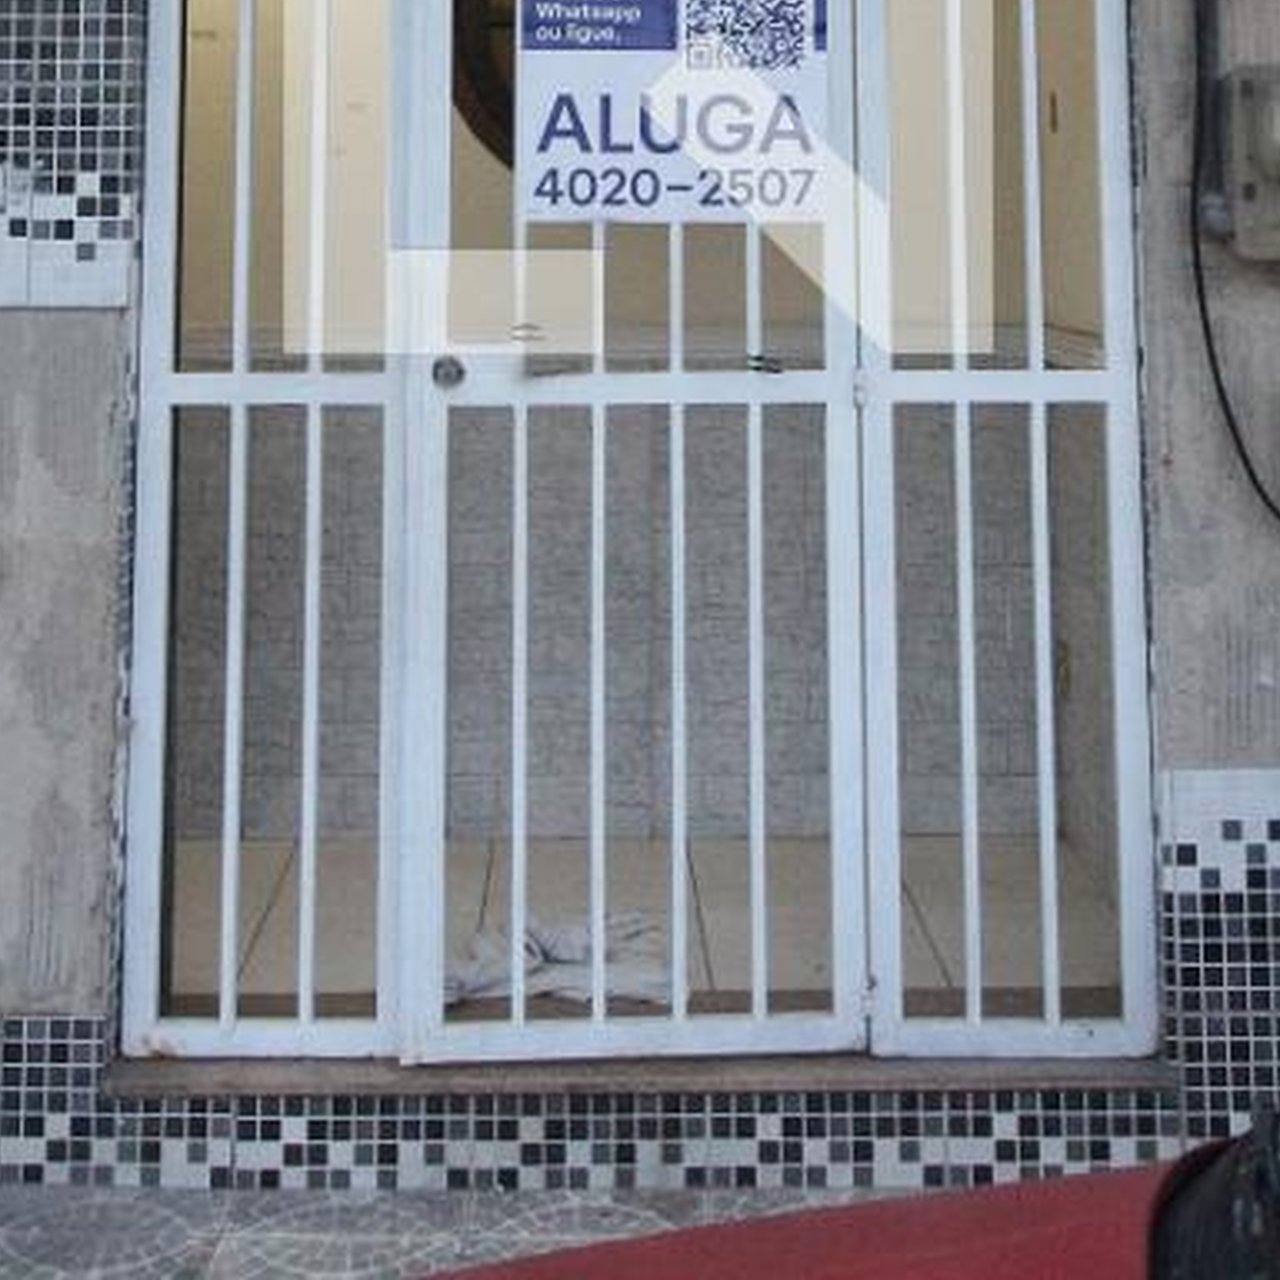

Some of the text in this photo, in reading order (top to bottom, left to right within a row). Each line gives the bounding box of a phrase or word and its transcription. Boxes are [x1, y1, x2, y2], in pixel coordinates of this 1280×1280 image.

[536, 27, 561, 41] ou
[537, 93, 814, 155] ALUGA
[534, 167, 816, 207] 4020-2507
